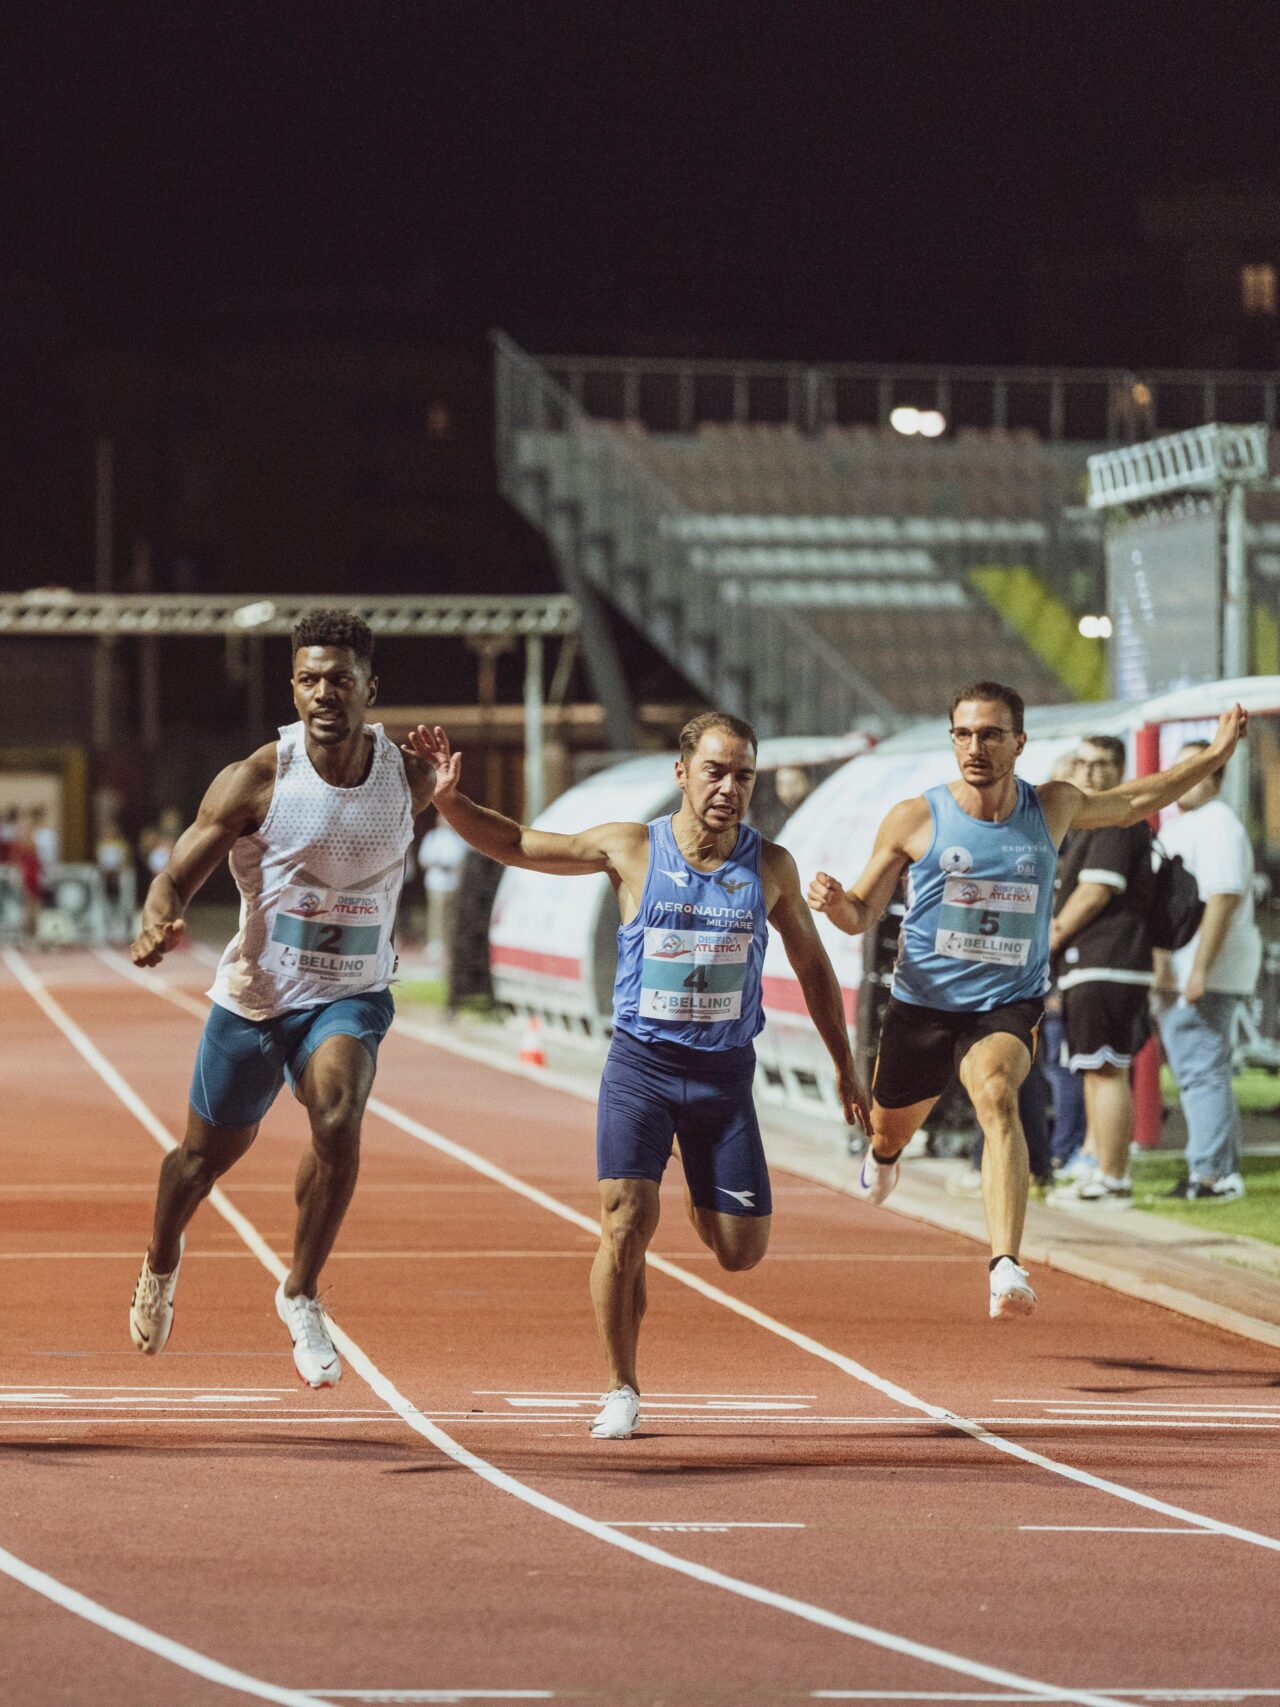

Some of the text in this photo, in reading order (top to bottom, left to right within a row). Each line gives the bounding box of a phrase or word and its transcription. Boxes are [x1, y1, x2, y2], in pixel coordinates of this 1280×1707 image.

[989, 892, 1031, 902] ATLETICA
[331, 904, 379, 915] ATLETICA
[654, 900, 754, 920] AERONAUTICA
[706, 918, 753, 930] MILITARE
[978, 910, 1001, 936] 5
[317, 925, 343, 954] 2
[698, 935, 738, 945] DISFIDA
[963, 938, 1022, 953] BELLINO
[693, 944, 741, 953] ATLETICA
[299, 955, 364, 972] BELLINO
[683, 965, 708, 994] 4
[669, 996, 732, 1009] BELLINO
